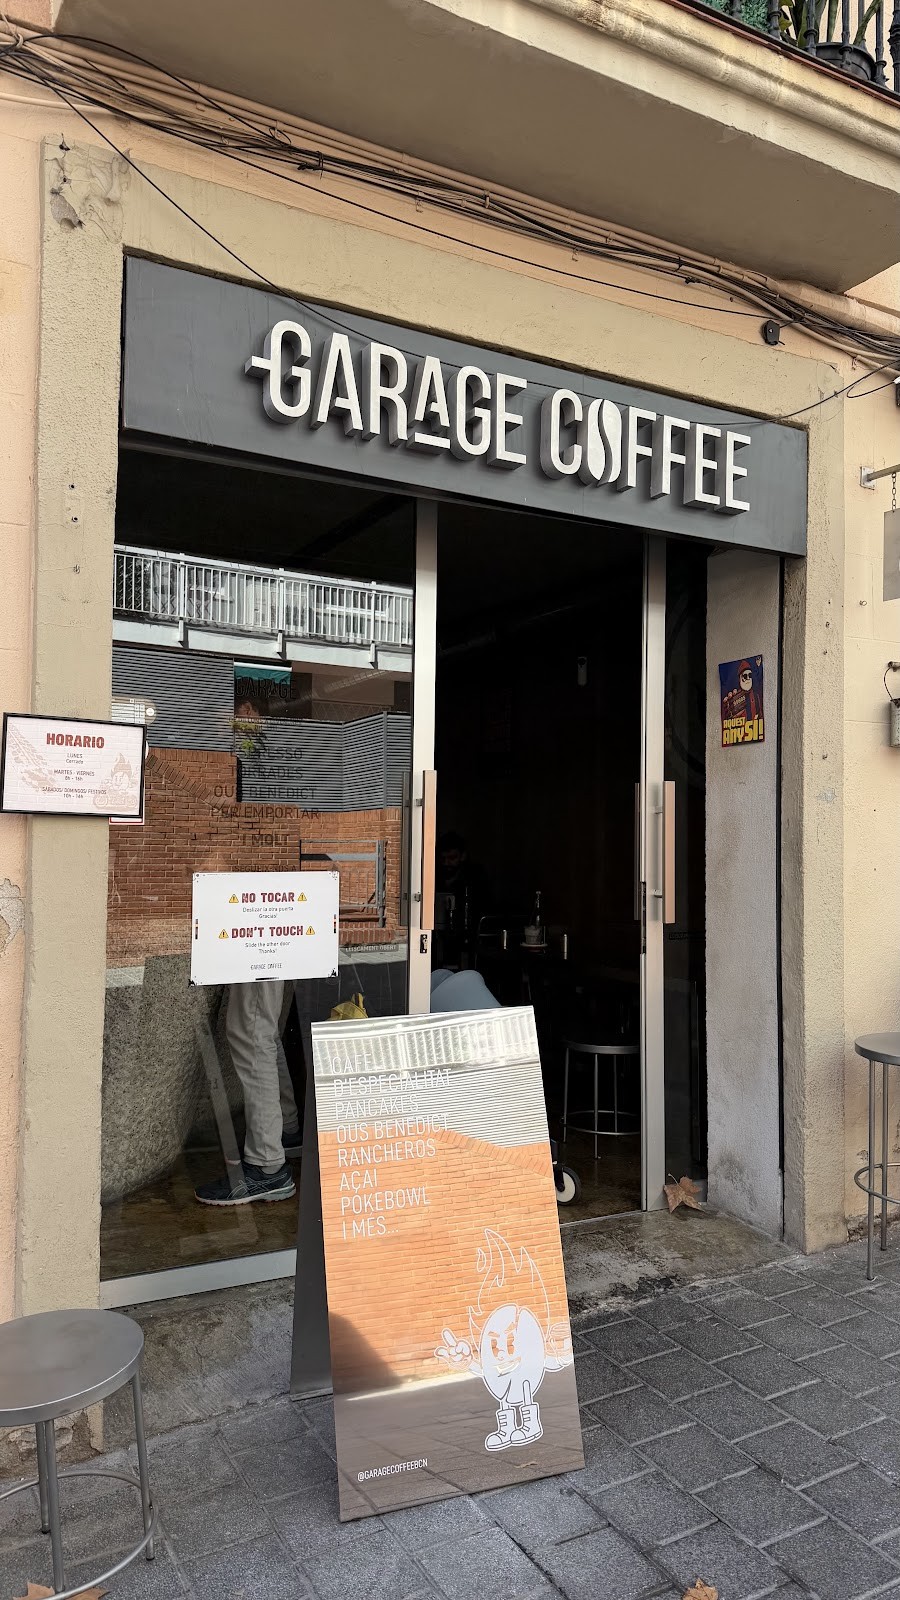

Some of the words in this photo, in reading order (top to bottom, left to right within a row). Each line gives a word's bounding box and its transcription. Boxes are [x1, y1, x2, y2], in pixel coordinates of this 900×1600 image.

[248, 320, 527, 467] GARAGE
[544, 389, 751, 513] COFFEE
[235, 677, 297, 699] GARAGE
[723, 716, 746, 730] AQUEST
[46, 732, 105, 749] HORARIO
[722, 726, 745, 745] ANY
[249, 786, 317, 799] BENEDICT
[210, 806, 242, 818] PER
[244, 806, 319, 820] EMPORTAR
[251, 833, 290, 846] MOLT
[241, 892, 256, 903] NO
[261, 892, 295, 903] TOCAR
[231, 926, 264, 938] DON'T
[269, 925, 304, 937] TOUCH
[333, 1068, 452, 1097] D'ESPECIALITAT
[334, 1094, 419, 1120] PANCAKES
[336, 1122, 369, 1144] OUS
[374, 1113, 450, 1139] BENEDICT
[337, 1138, 436, 1168] RANCHEROS
[339, 1168, 378, 1194] AÇAI
[341, 1185, 431, 1216] POKEBOWL
[342, 1221, 347, 1240] I
[357, 1458, 428, 1482] @GARAGECOFFEEBCN
